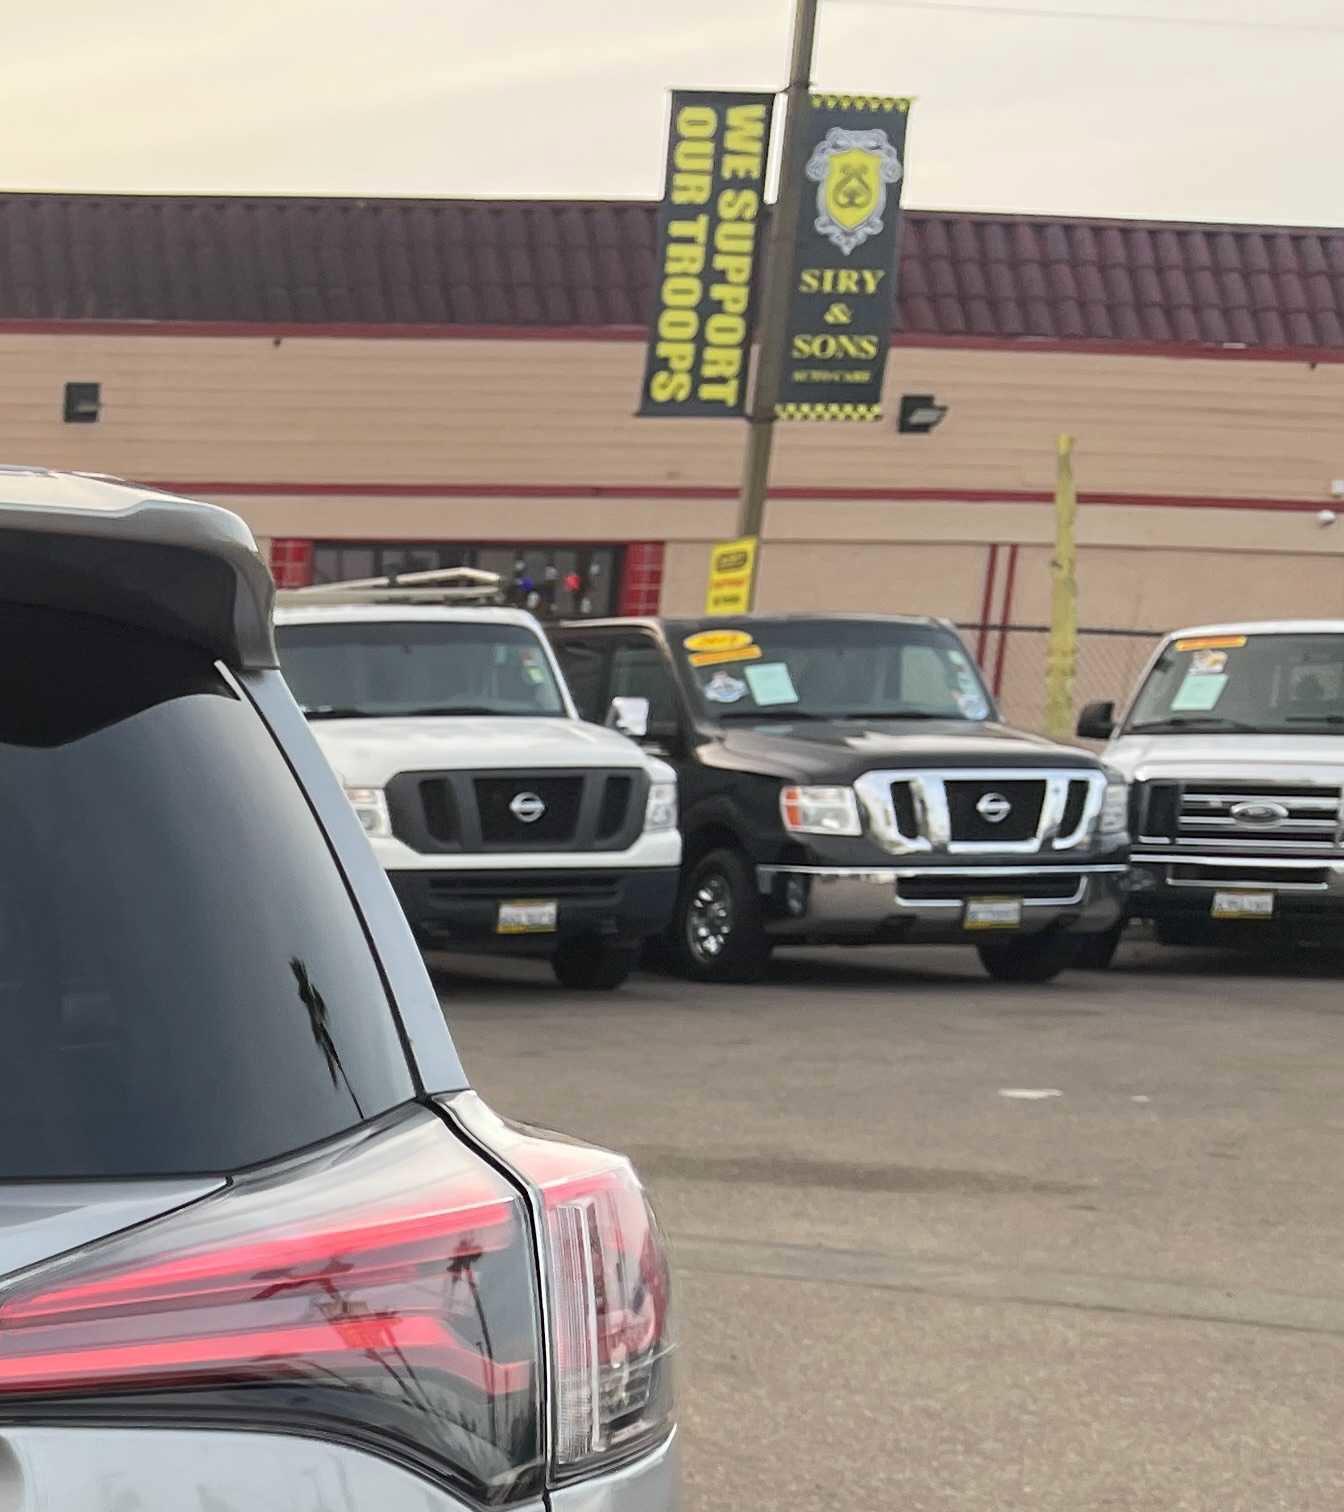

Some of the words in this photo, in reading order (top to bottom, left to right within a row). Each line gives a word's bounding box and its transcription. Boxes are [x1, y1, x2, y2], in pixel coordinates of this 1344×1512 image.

[671, 106, 717, 205] OUR
[722, 104, 766, 180] WE
[650, 214, 709, 402] TROOPS
[698, 189, 759, 407] SUPPORT
[799, 268, 885, 294] SIRY
[824, 302, 852, 325] &
[792, 334, 879, 360] SONS
